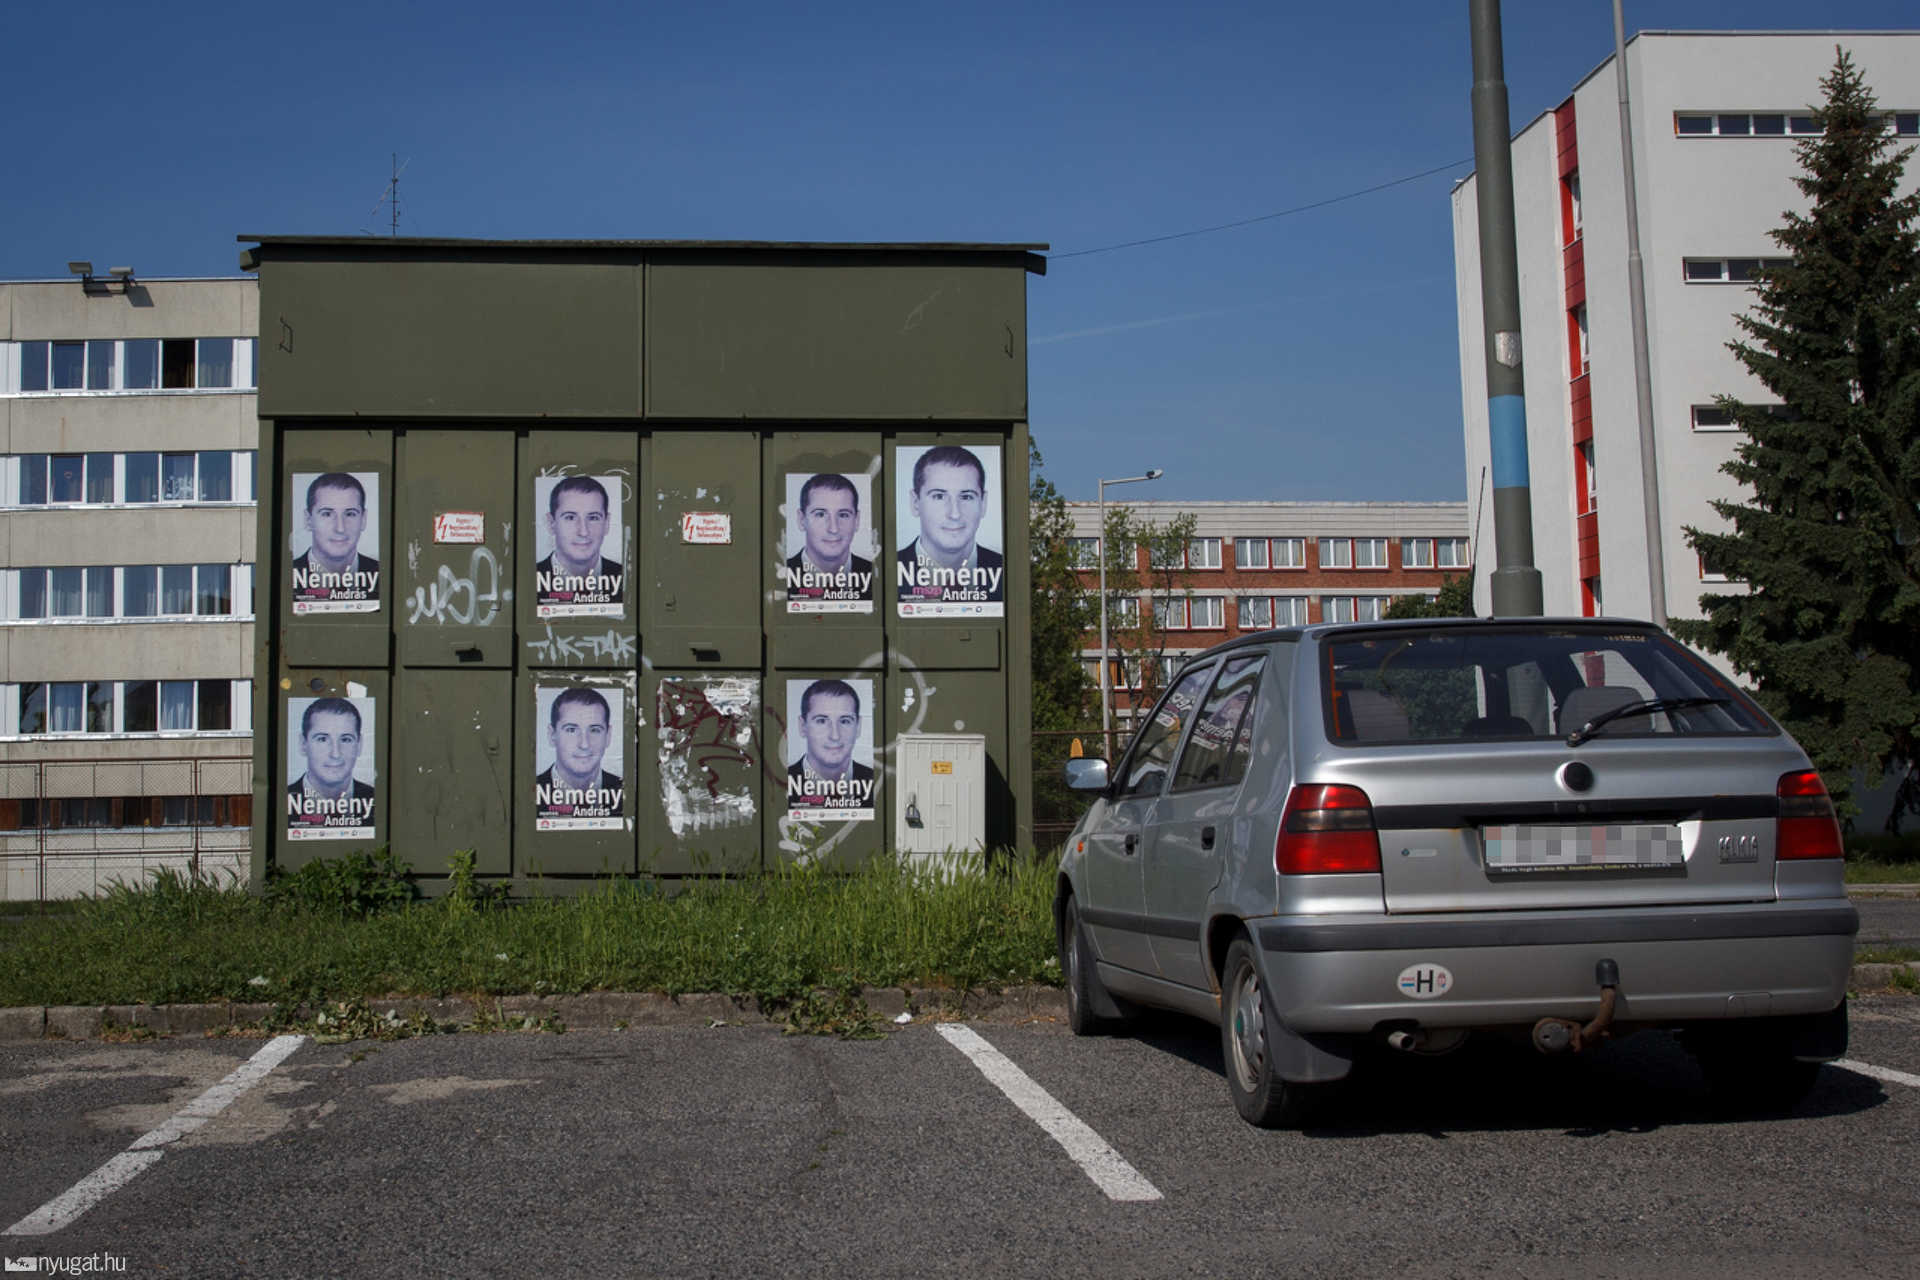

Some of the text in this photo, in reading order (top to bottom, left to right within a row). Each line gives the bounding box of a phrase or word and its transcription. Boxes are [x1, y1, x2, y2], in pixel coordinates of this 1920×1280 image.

[293, 564, 379, 593] Nemény
[536, 568, 622, 596] Nemény
[787, 565, 872, 593] Nemény
[897, 559, 1002, 593] Nemény
[329, 588, 367, 601] András
[573, 591, 610, 604] András
[823, 588, 860, 600] András
[942, 587, 988, 601] András
[536, 781, 622, 810] Nemény
[788, 772, 873, 801] Nemény
[288, 791, 374, 819] Nemény
[573, 804, 611, 817] András
[824, 796, 862, 808] András
[324, 814, 362, 826] András
[1416, 969, 1434, 993] H
